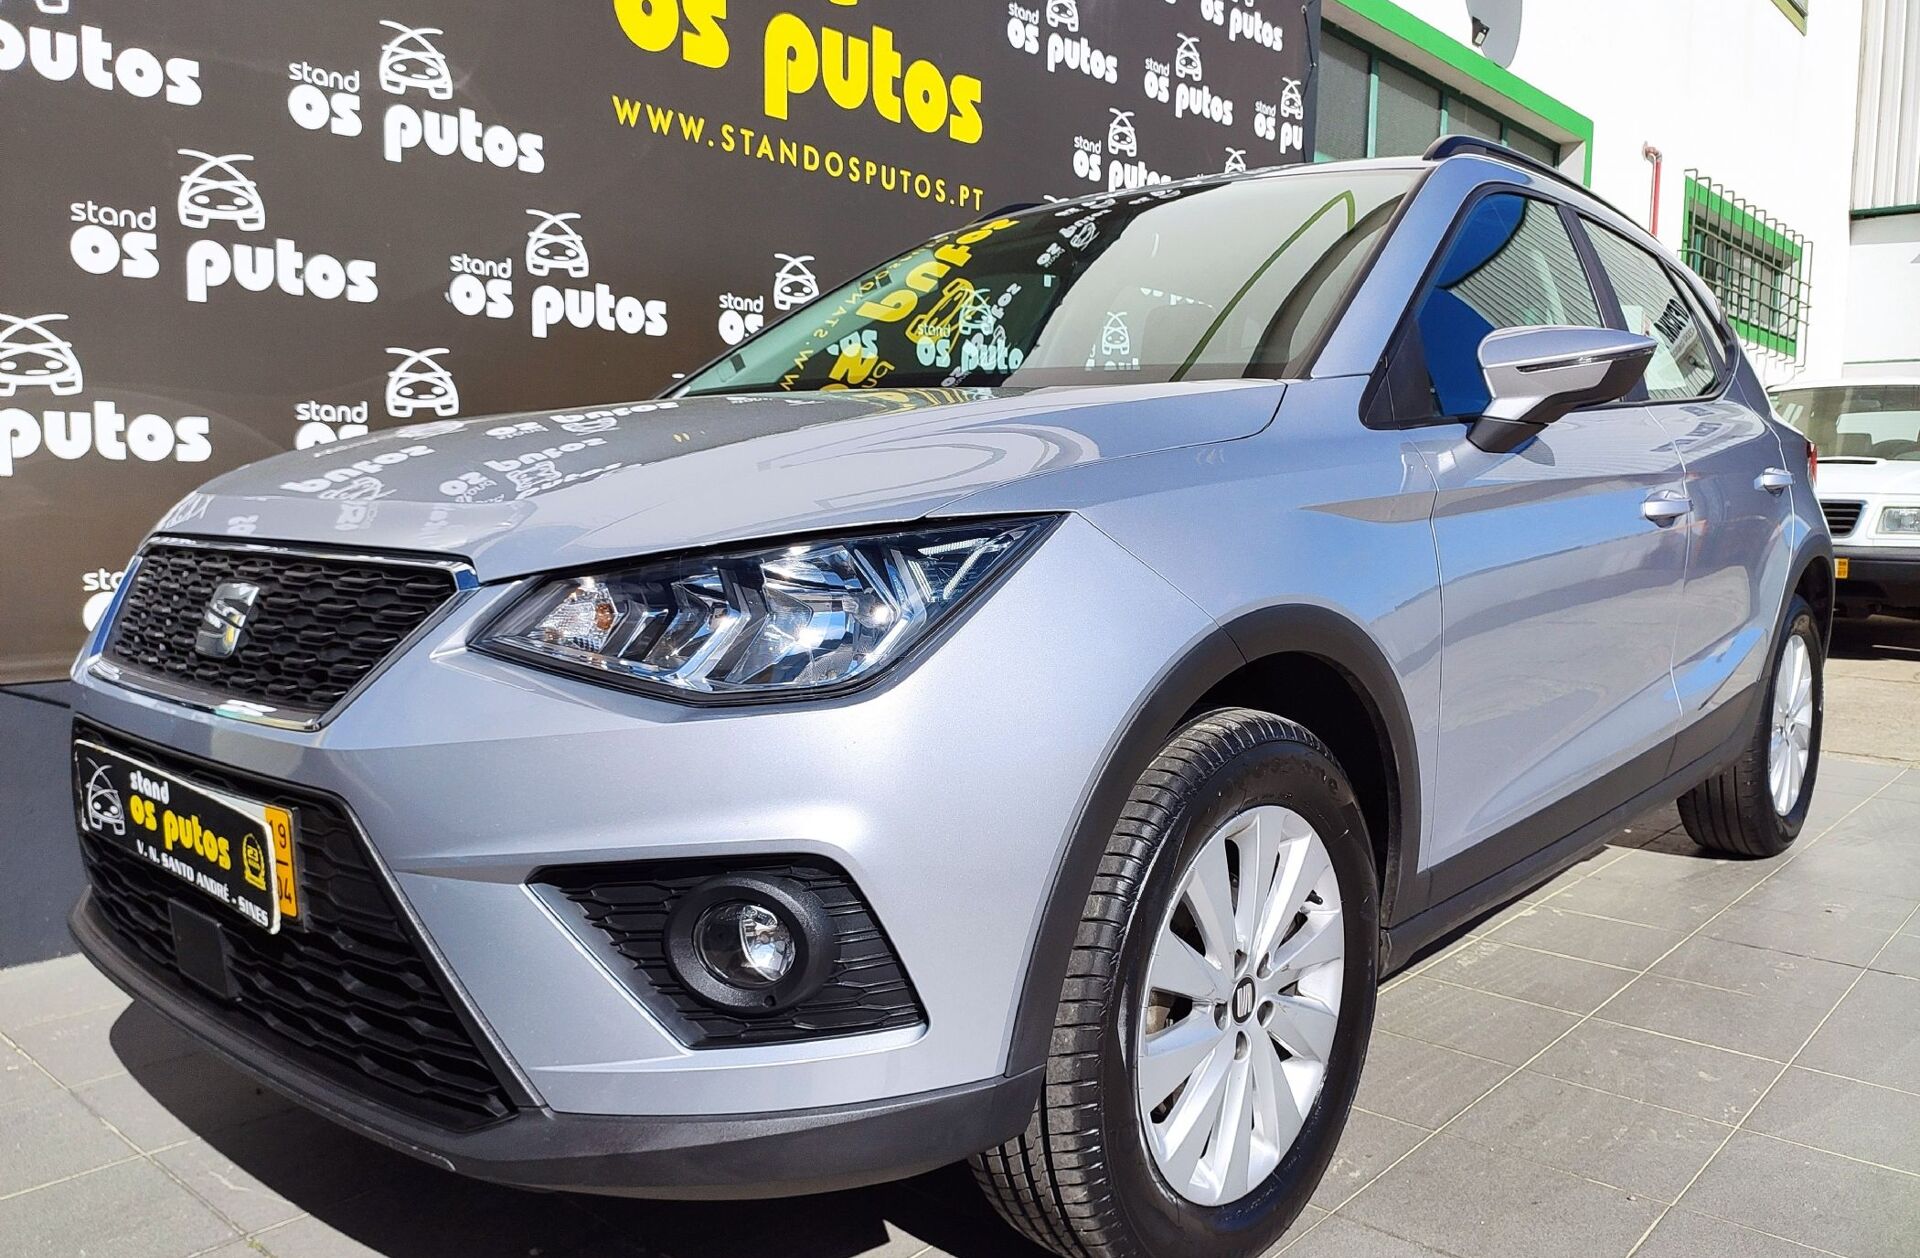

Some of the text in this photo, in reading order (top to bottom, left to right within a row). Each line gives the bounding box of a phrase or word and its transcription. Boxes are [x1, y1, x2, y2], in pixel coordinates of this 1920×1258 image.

[1008, 2, 1039, 25] stand
[1201, 0, 1283, 51] os putos
[1007, 18, 1117, 84] os putos
[1145, 58, 1169, 76] stand
[289, 61, 360, 92] stand
[614, 0, 983, 145] os putos
[1144, 70, 1233, 126] os putos
[1255, 101, 1276, 117] stand
[288, 84, 544, 173] os putos
[1254, 112, 1275, 141] os
[612, 95, 983, 211] WWW.STANDOSPUTOS.PT
[1074, 136, 1101, 154] stand
[1073, 149, 1101, 181] os
[70, 201, 156, 231] stand
[70, 225, 378, 302] os putos
[450, 253, 512, 279] stand
[449, 274, 668, 338] os putos
[719, 292, 763, 313] stand
[296, 400, 368, 424] stand
[0, 401, 212, 476] putos
[130, 770, 169, 804] stand
[130, 794, 232, 870] os putos
[161, 852, 195, 882] SANTO
[196, 872, 230, 903] ANDRÉ
[237, 896, 269, 927] SINES
